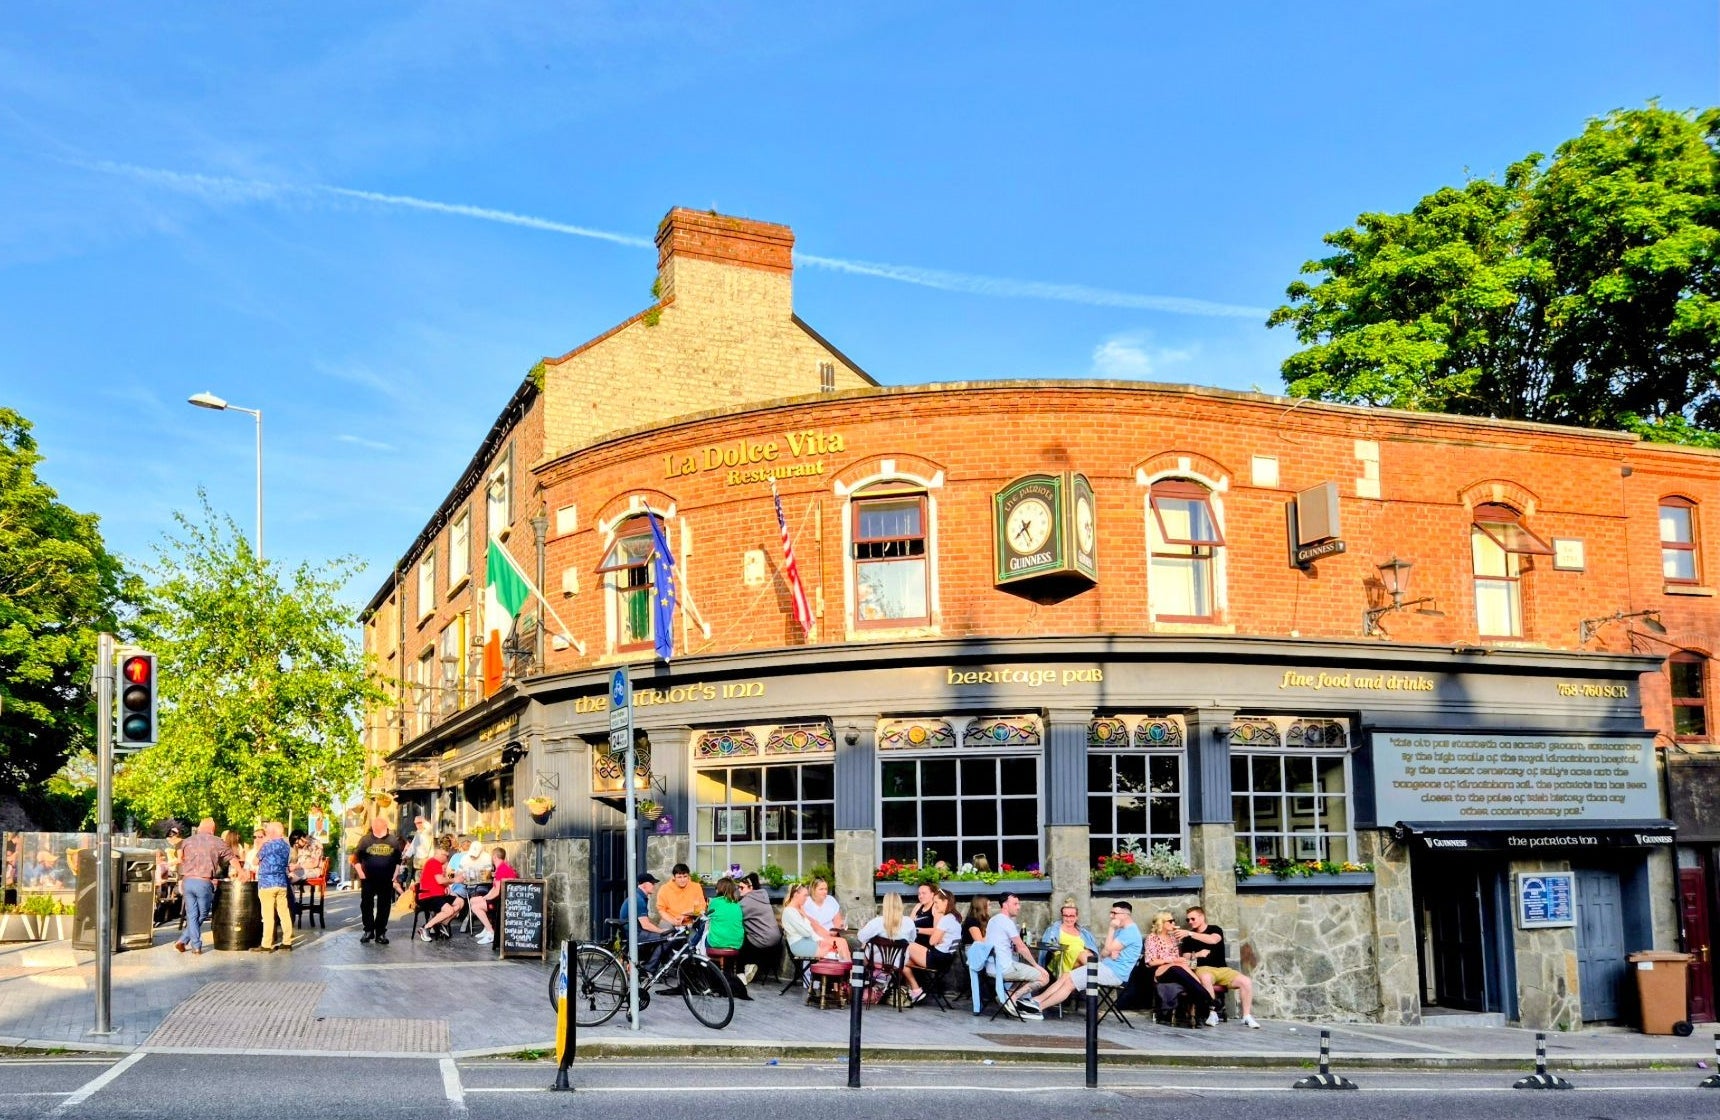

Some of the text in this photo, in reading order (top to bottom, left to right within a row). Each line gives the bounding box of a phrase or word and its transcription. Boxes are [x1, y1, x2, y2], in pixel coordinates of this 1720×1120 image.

[663, 429, 846, 479] La Dolce Vita
[727, 459, 825, 486] Restaurant
[1010, 551, 1053, 570] GUINNESS
[1298, 542, 1335, 560] GUINNESS
[947, 668, 1057, 687] heritage
[1280, 671, 1435, 691] fine food and drinks
[575, 695, 608, 714] the
[722, 681, 765, 699] inn
[1602, 685, 1629, 699] SCR
[1507, 835, 1527, 846] the
[1529, 835, 1579, 848] patriots
